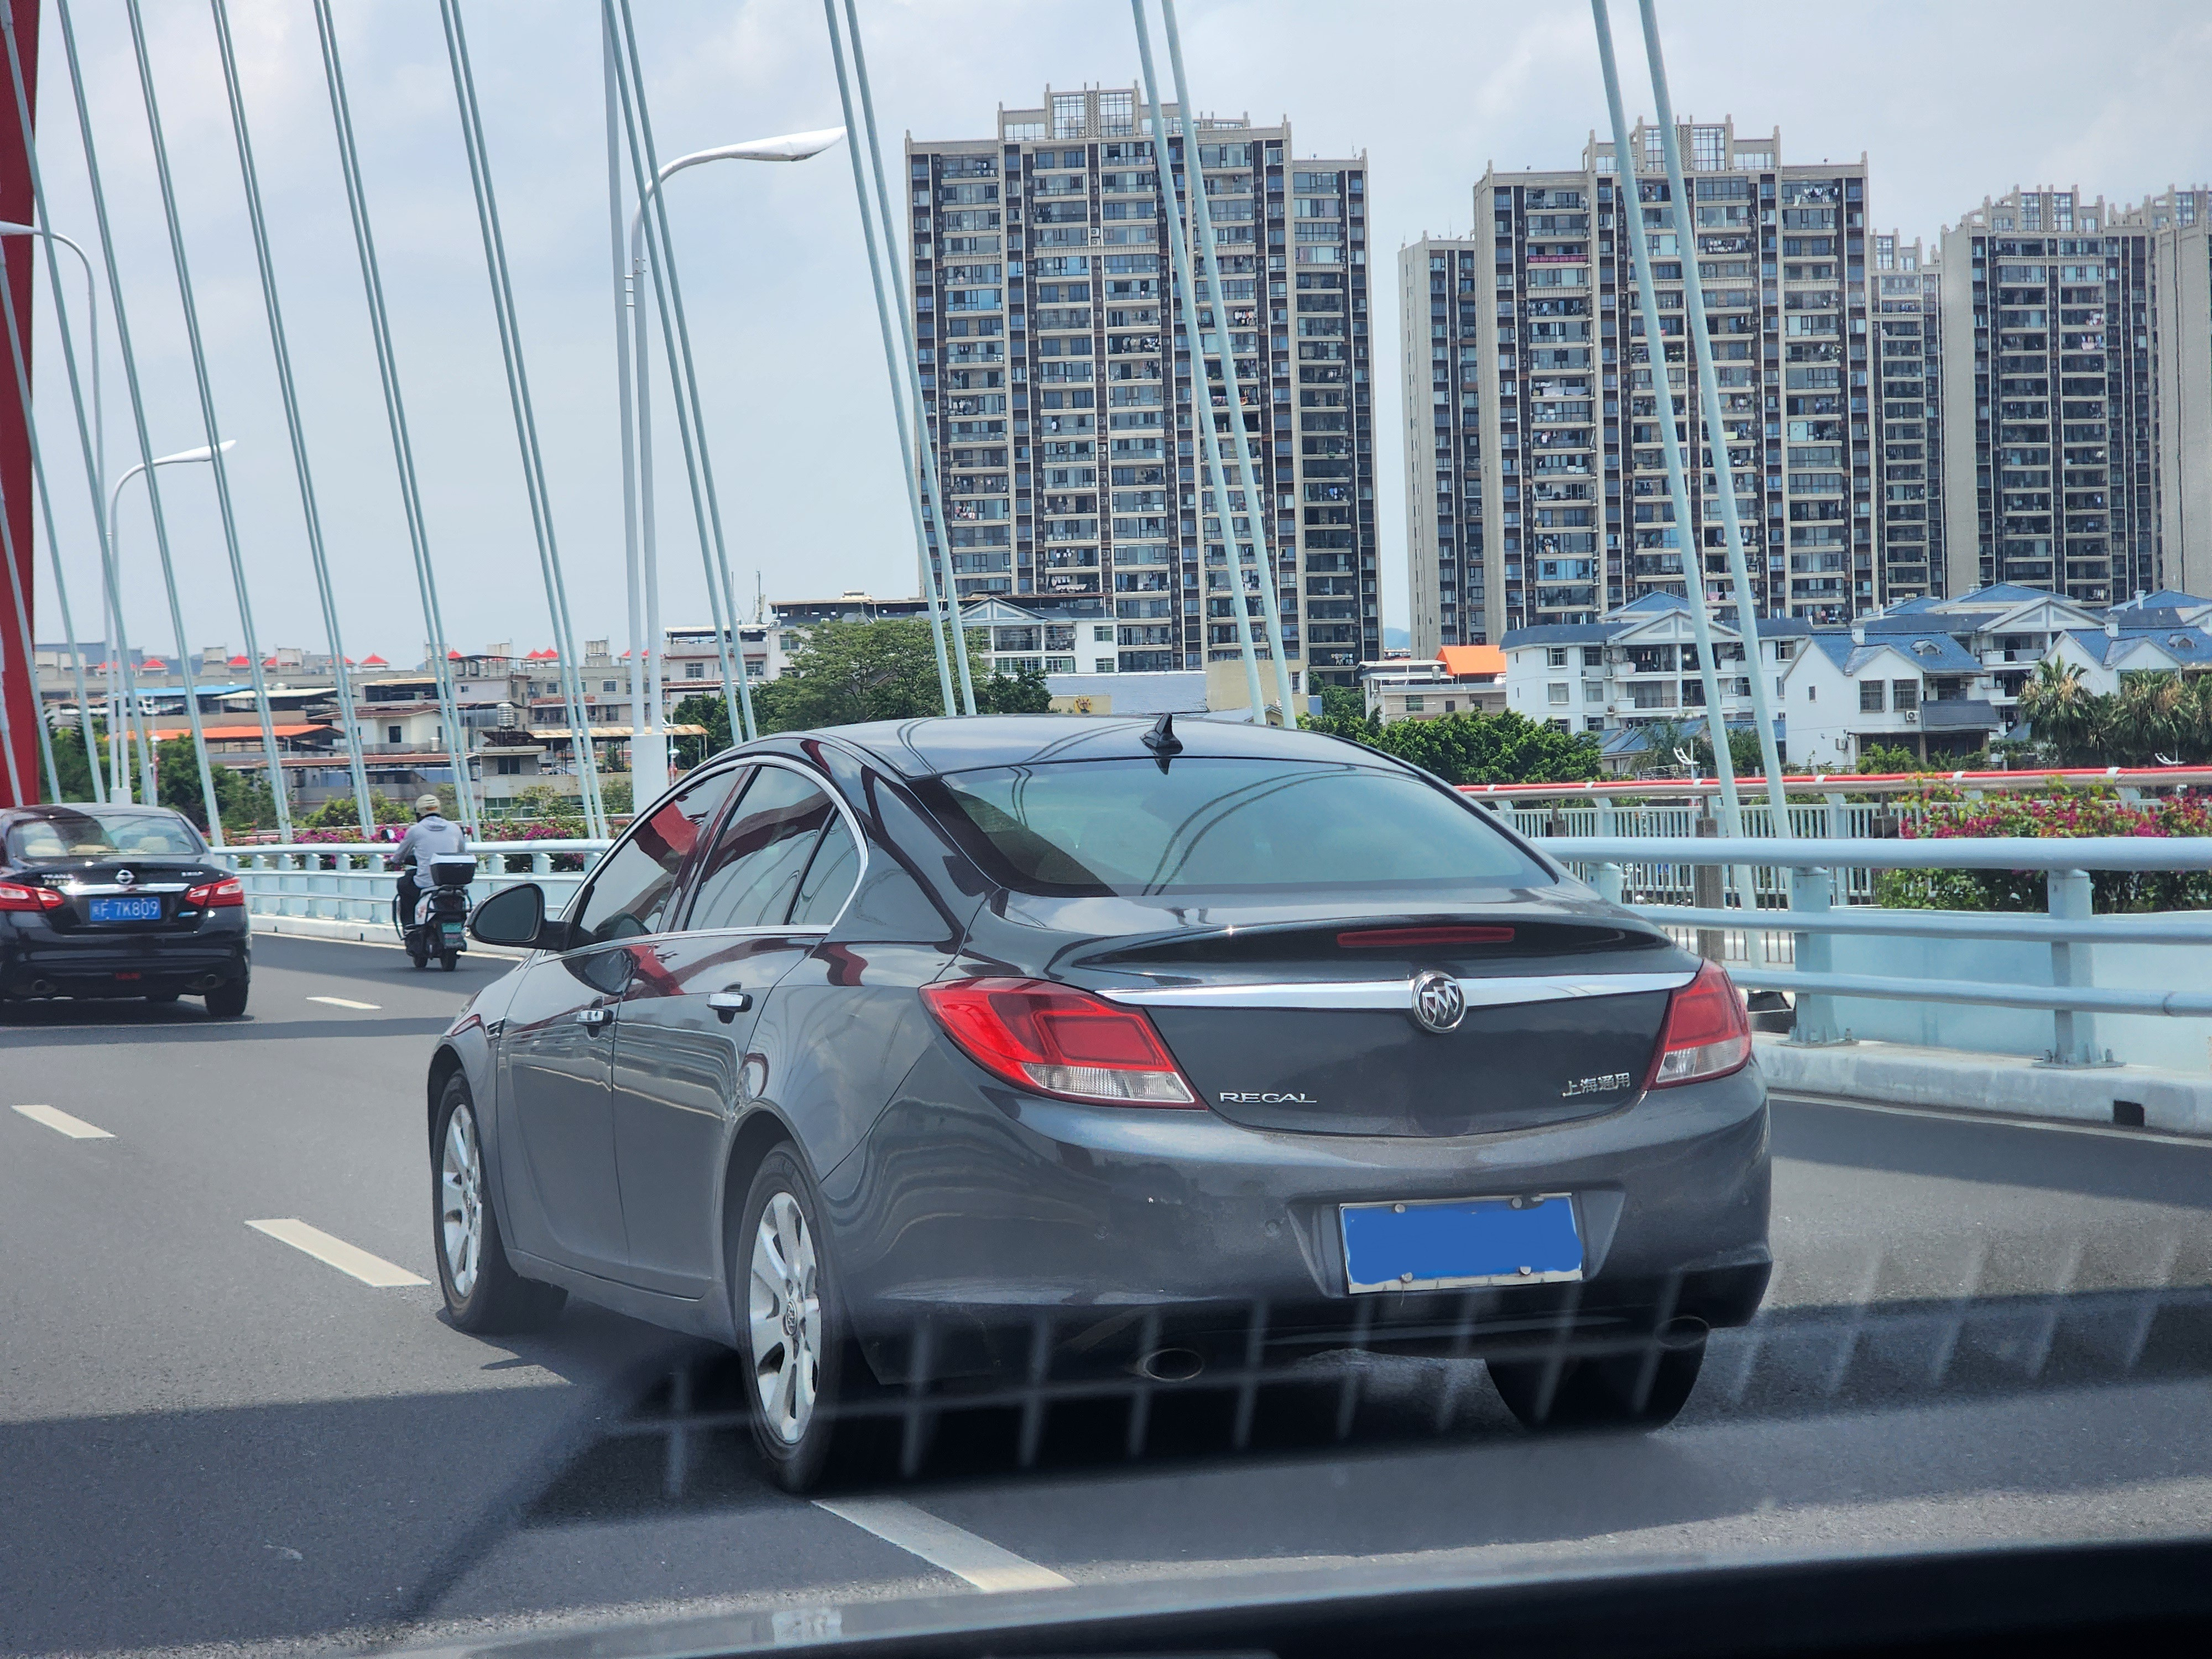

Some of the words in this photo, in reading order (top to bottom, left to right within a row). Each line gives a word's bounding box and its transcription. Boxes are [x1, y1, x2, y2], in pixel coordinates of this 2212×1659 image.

[1562, 1072, 1631, 1097] 上海通用
[1219, 1092, 1317, 1103] REGAL
